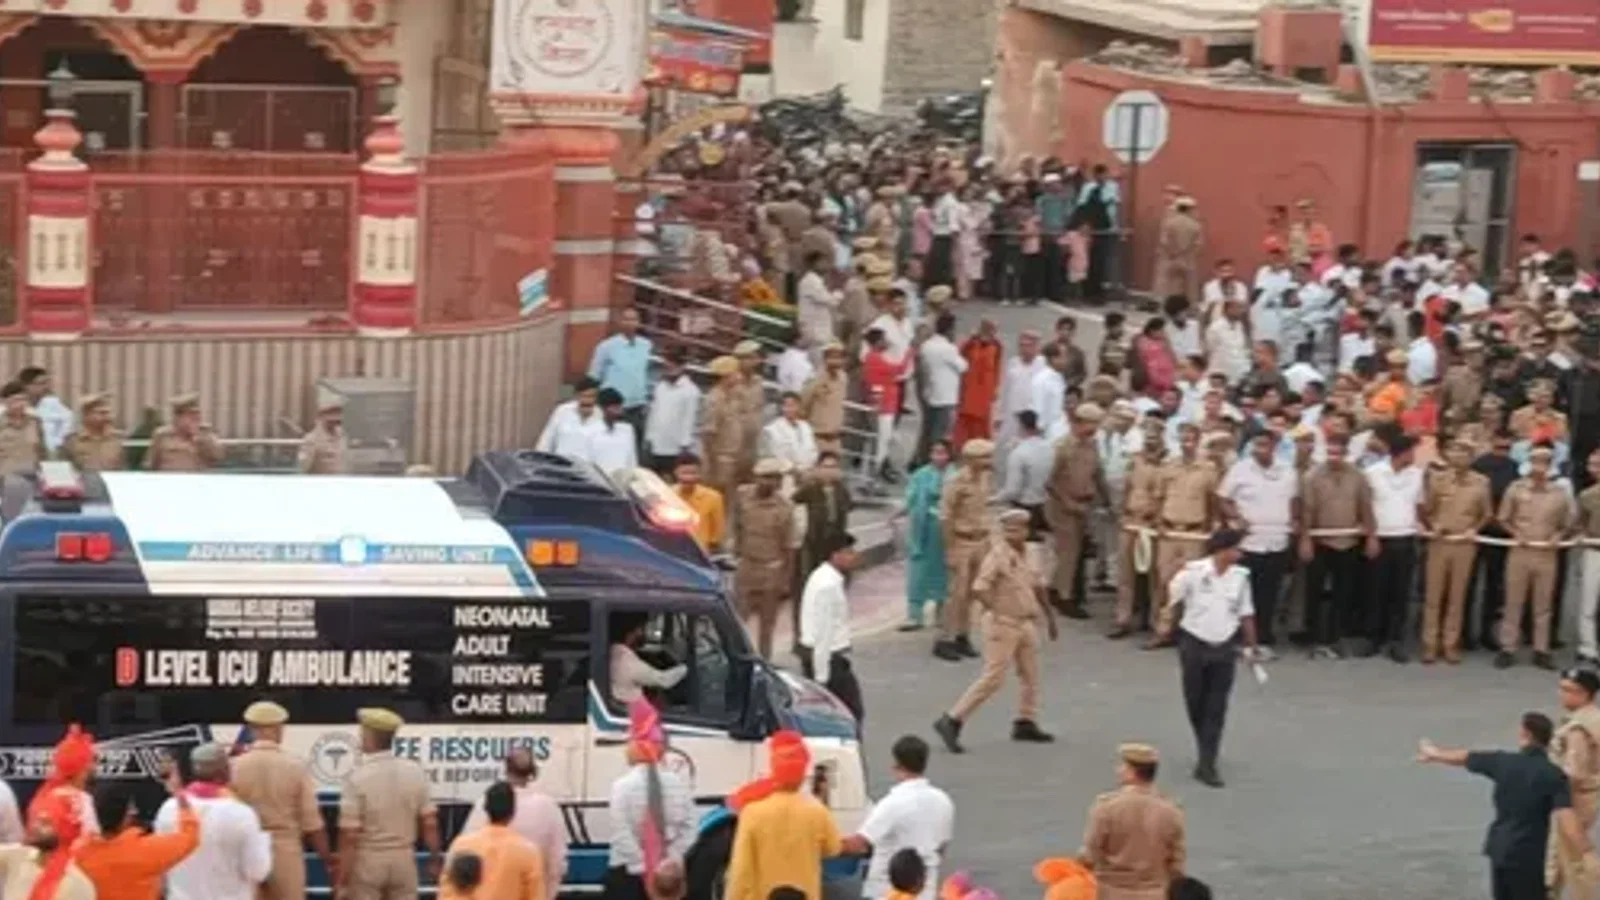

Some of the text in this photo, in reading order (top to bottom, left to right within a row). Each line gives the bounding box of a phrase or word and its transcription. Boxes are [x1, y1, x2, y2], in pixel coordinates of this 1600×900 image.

[187, 544, 495, 562] ADVANCE LIFE SAVING UNIT
[453, 605, 551, 627] NEONATAL
[452, 634, 511, 656] ADULT
[145, 649, 213, 685] LEVEL
[218, 649, 259, 686] ICU
[269, 649, 411, 685] AMBULANCE
[452, 664, 543, 685] INTENSIVE
[452, 693, 548, 715] CARE UNIT
[394, 736, 422, 761] FE
